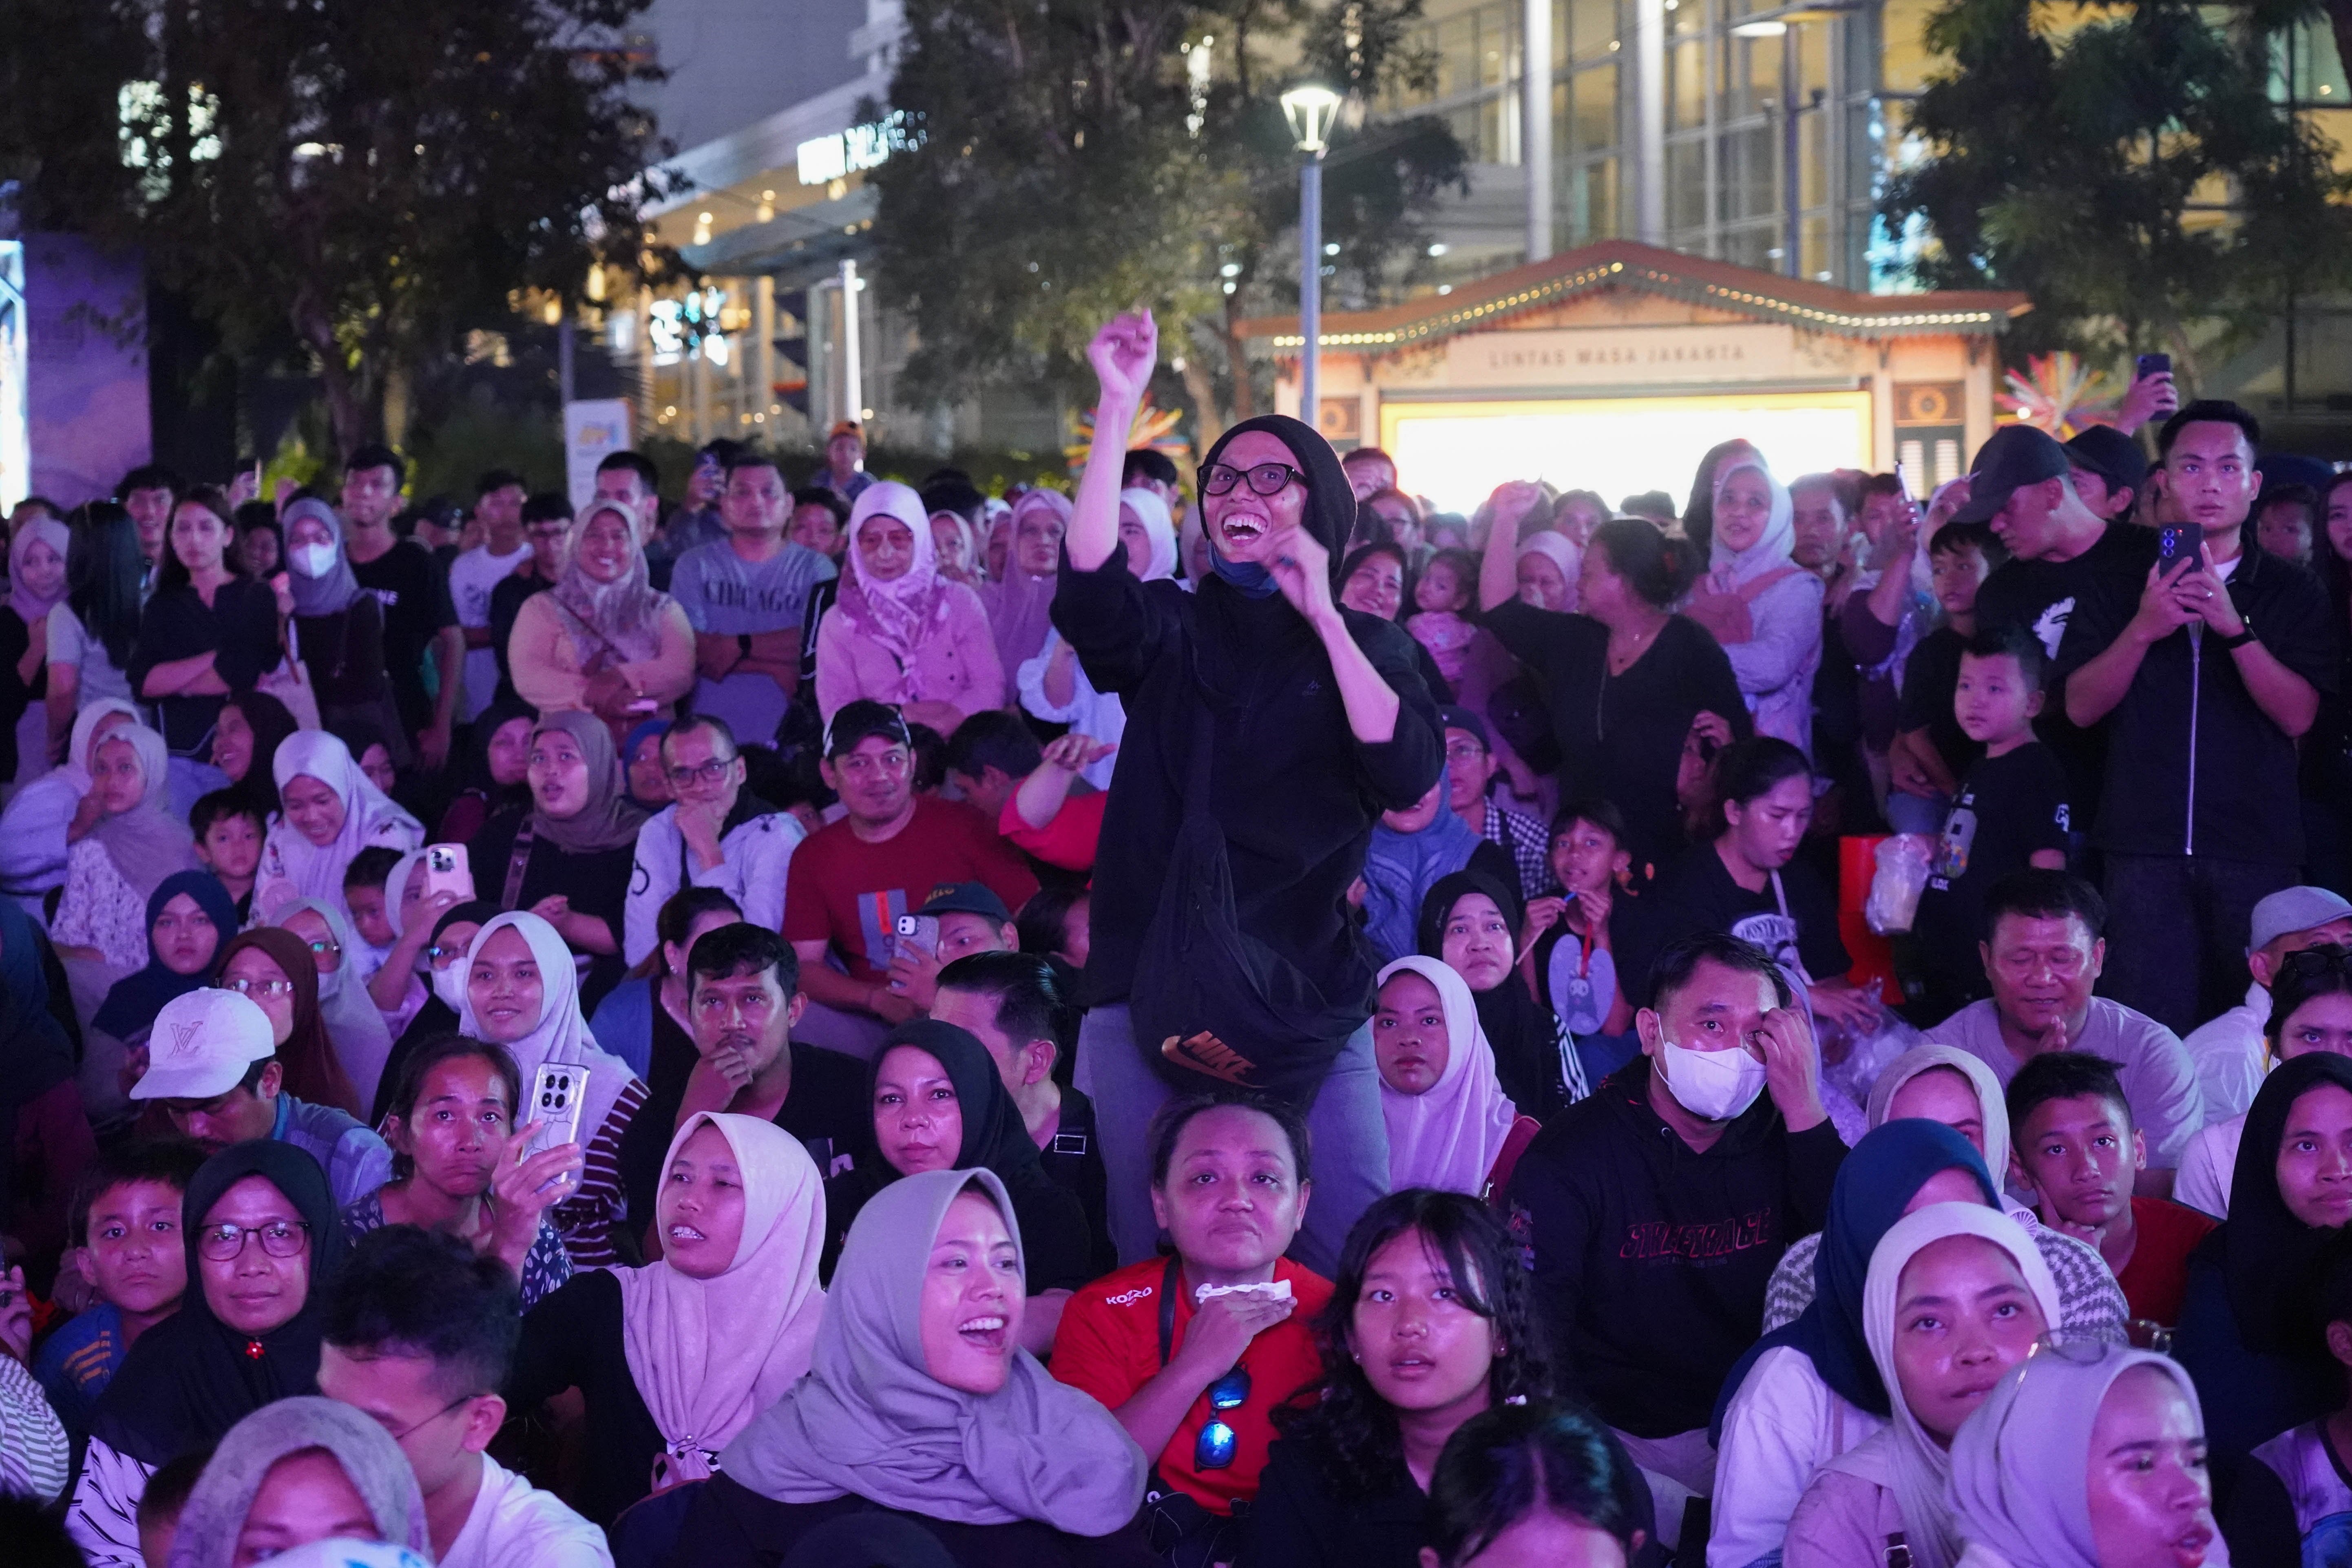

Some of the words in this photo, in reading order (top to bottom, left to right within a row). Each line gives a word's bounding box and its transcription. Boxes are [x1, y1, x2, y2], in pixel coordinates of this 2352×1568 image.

[1488, 348, 1566, 369] LINTAS
[1647, 344, 1744, 364] JAKARTA
[703, 580, 801, 613] CHICAGO
[1182, 1030, 1258, 1075] NIKE
[1105, 1286, 1153, 1305] KOZZO
